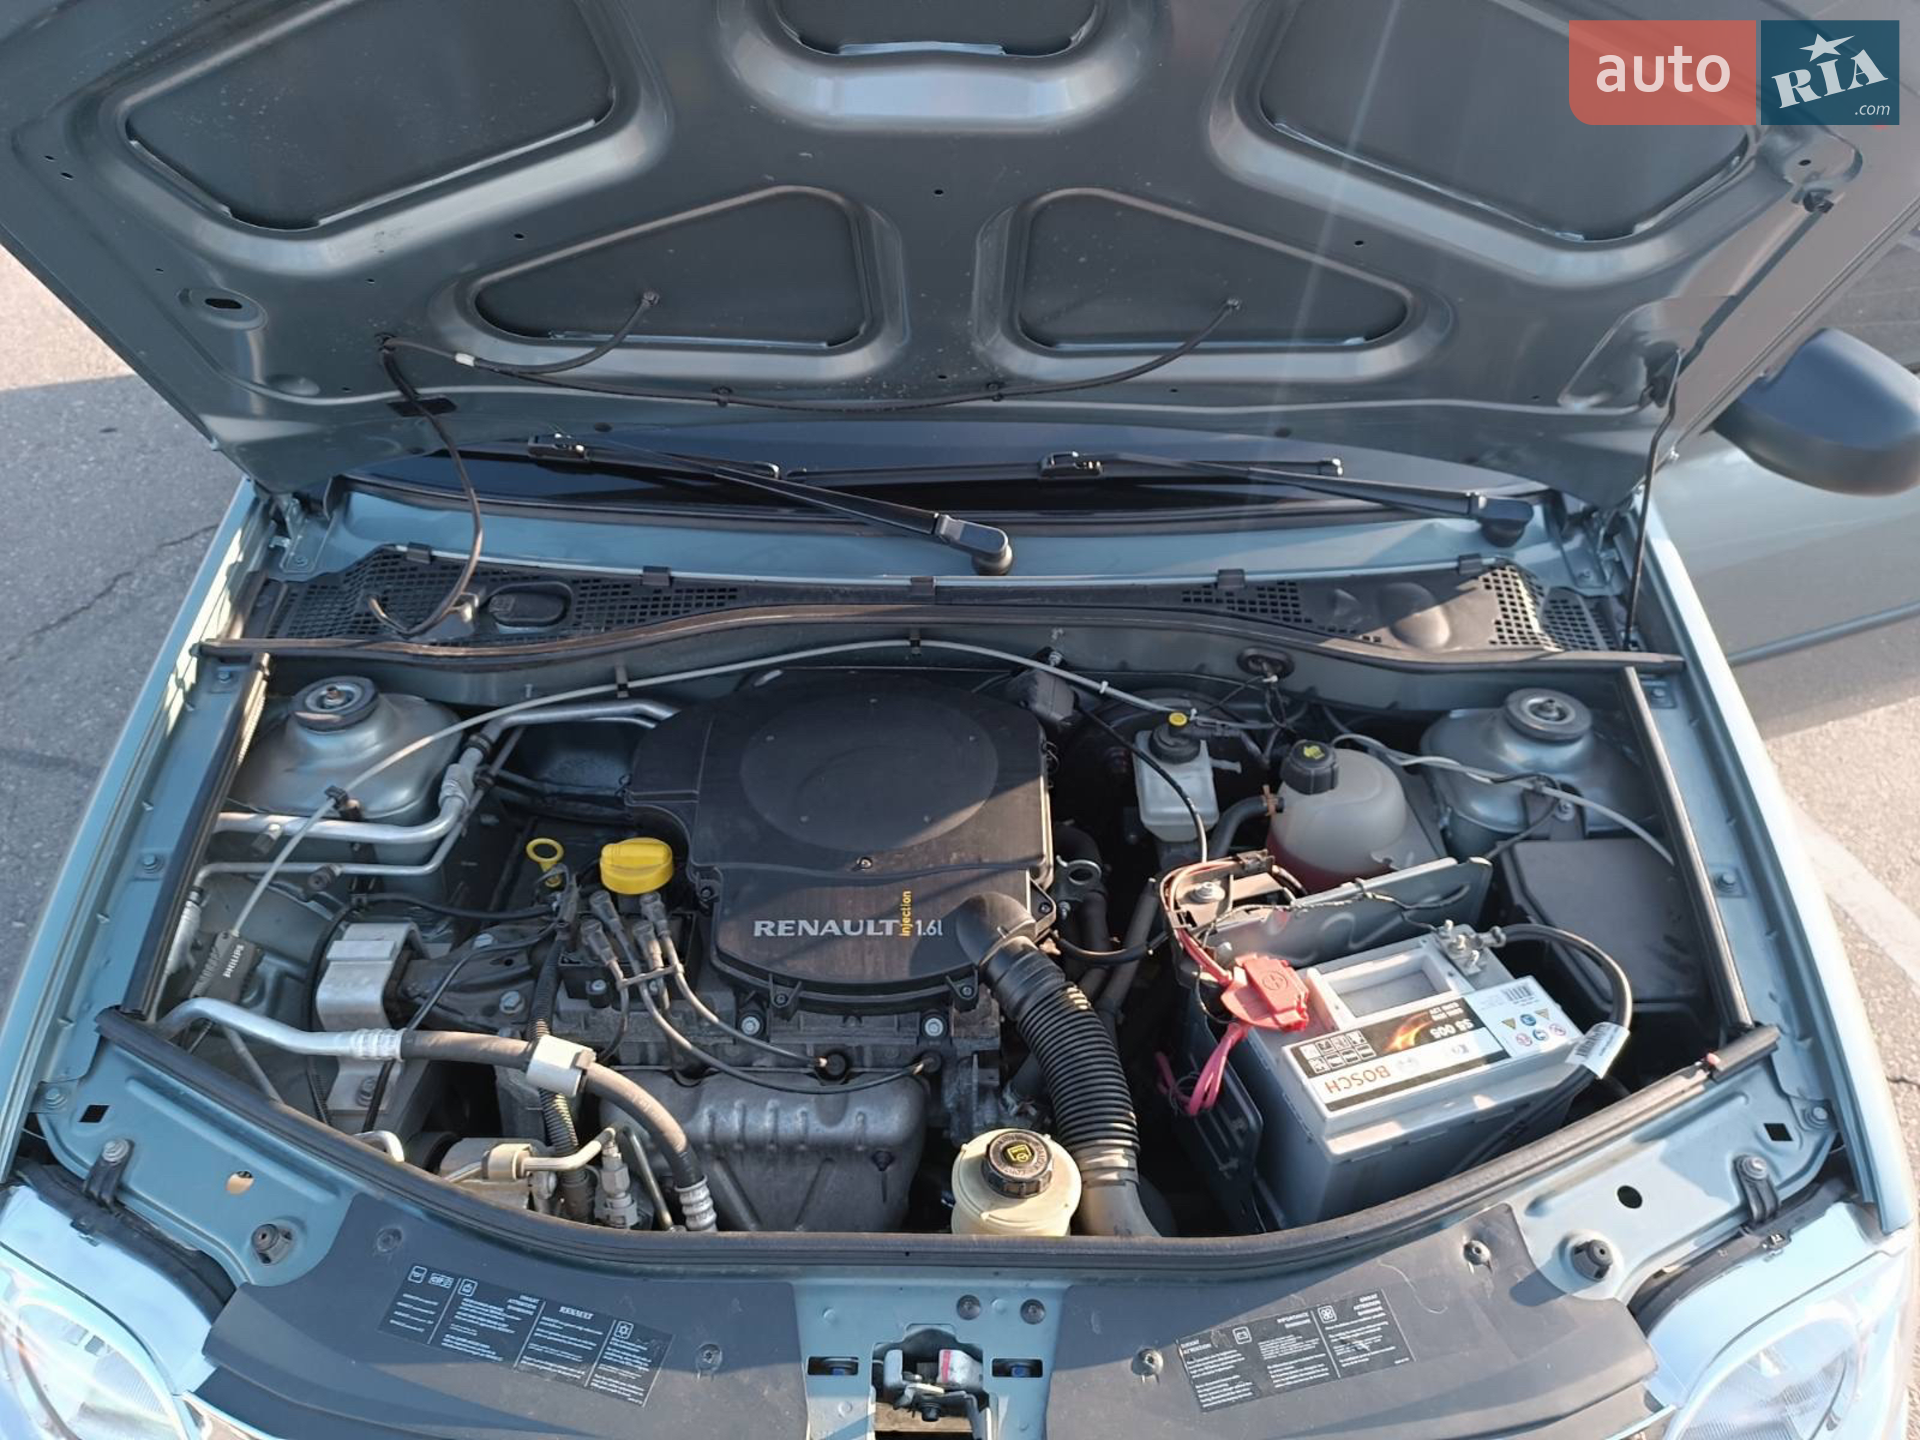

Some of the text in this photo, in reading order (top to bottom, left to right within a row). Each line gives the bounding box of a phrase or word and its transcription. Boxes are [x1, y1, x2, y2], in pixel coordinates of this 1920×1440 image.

[753, 919, 900, 937] RENAULT
[222, 945, 245, 978] PHILIPS
[1323, 1064, 1392, 1095] BOSCH
